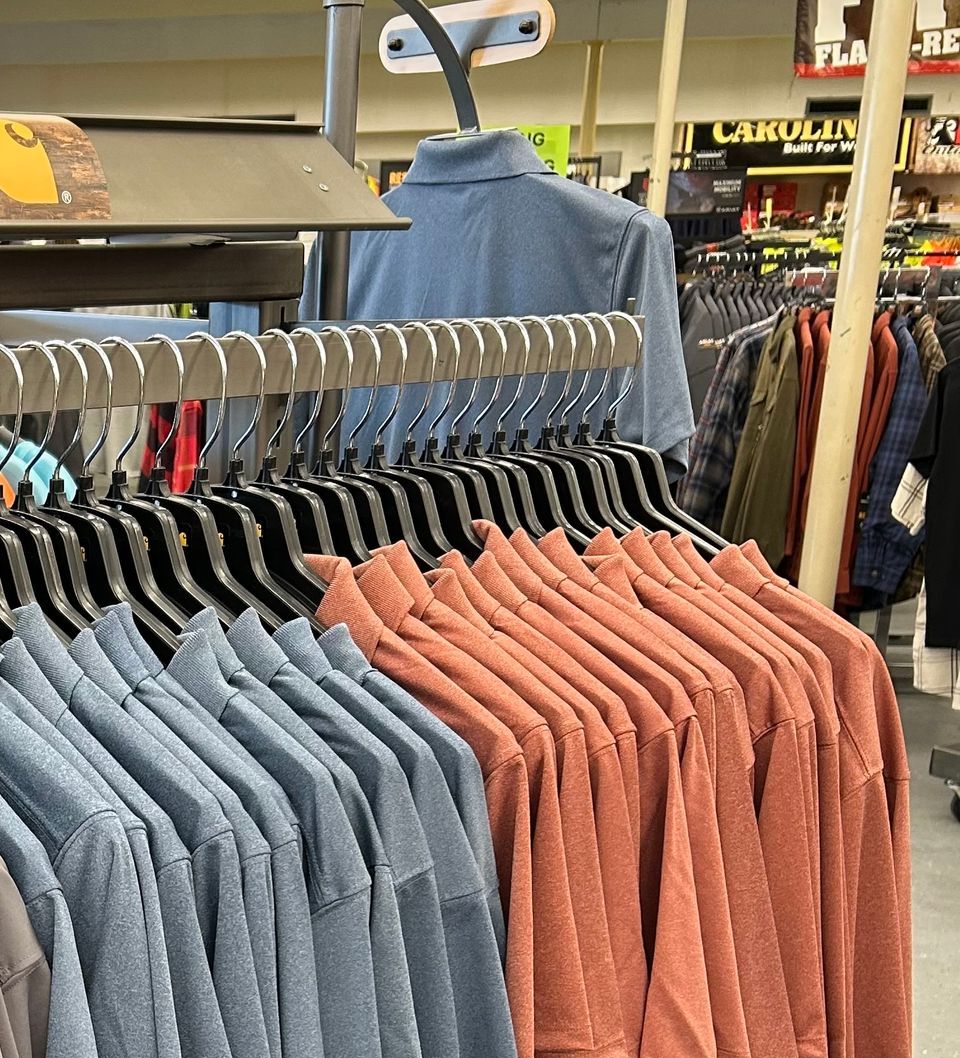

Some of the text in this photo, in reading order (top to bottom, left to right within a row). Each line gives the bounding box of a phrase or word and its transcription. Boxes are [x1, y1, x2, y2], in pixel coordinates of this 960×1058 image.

[712, 120, 858, 144] CAROLIN
[783, 142, 813, 155] Built
[815, 141, 837, 153] For
